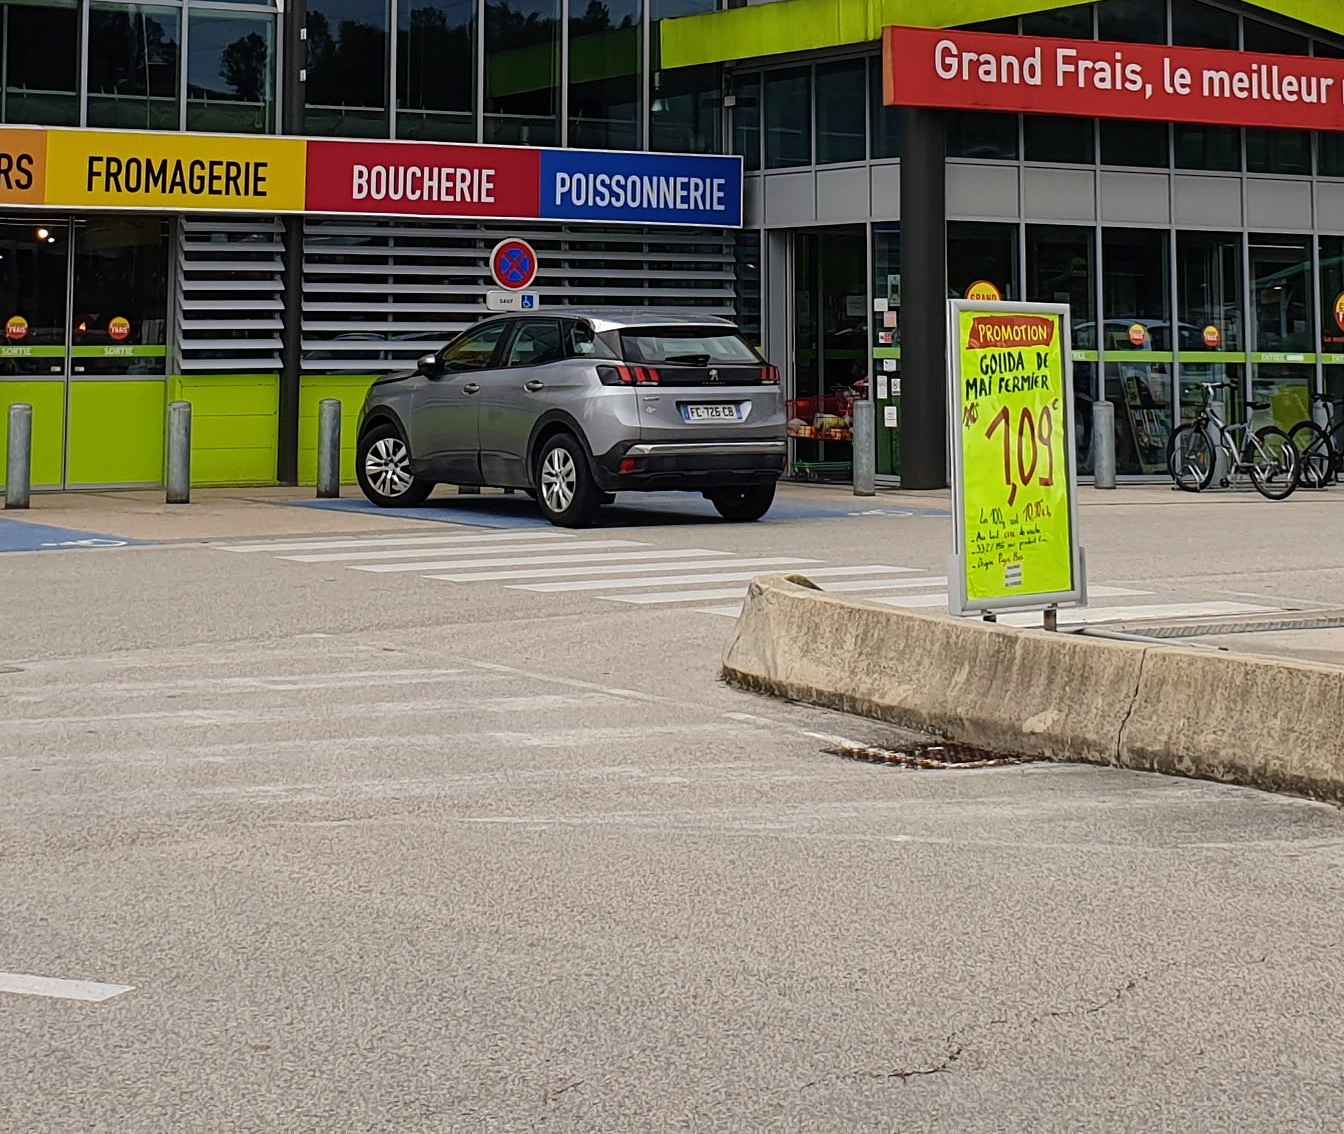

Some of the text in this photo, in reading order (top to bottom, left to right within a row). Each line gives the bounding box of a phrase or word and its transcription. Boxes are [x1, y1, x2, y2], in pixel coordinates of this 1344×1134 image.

[935, 39, 1042, 85] Grand
[1057, 48, 1153, 100] Frais,
[1163, 57, 1192, 95] le
[1202, 63, 1334, 106] meilleur
[87, 156, 269, 198] FROMAGERIE
[352, 165, 495, 204] BOUCHERIE
[555, 172, 726, 212] POISSONNERIE
[978, 324, 1048, 343] PROMOTION
